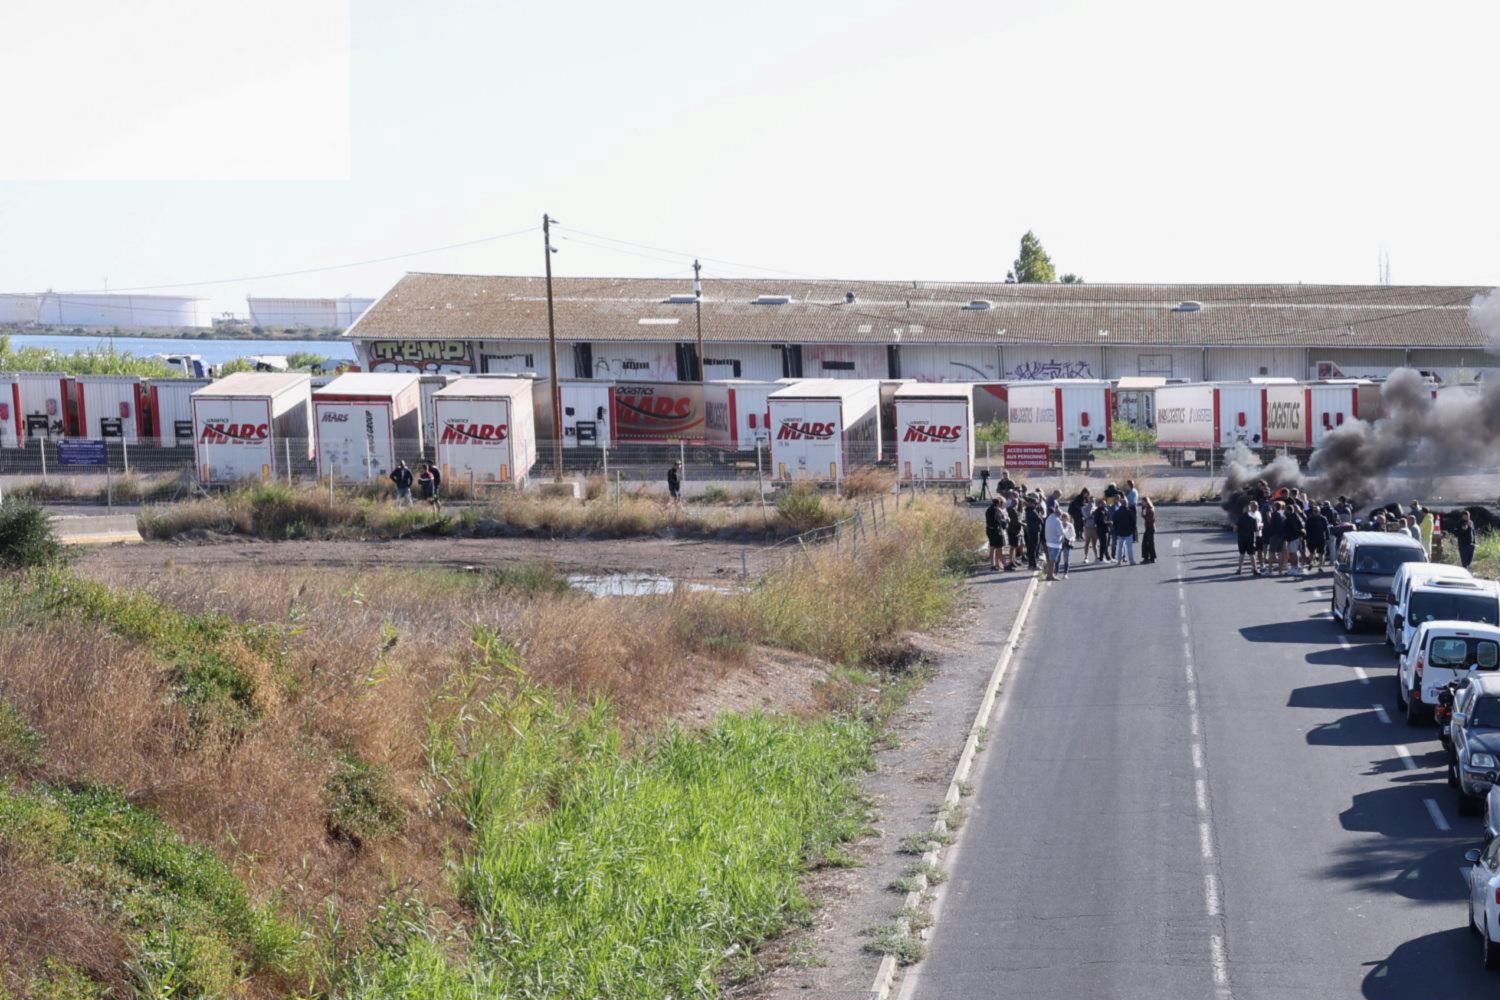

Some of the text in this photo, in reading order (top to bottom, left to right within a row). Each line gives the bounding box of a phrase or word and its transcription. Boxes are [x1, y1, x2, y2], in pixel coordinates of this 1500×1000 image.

[321, 413, 349, 423] MARS
[1268, 402, 1300, 429] LOGISTICS
[199, 424, 269, 445] MARS
[440, 424, 508, 445] MARS
[777, 423, 836, 440] MARS
[903, 426, 962, 442] MARS
